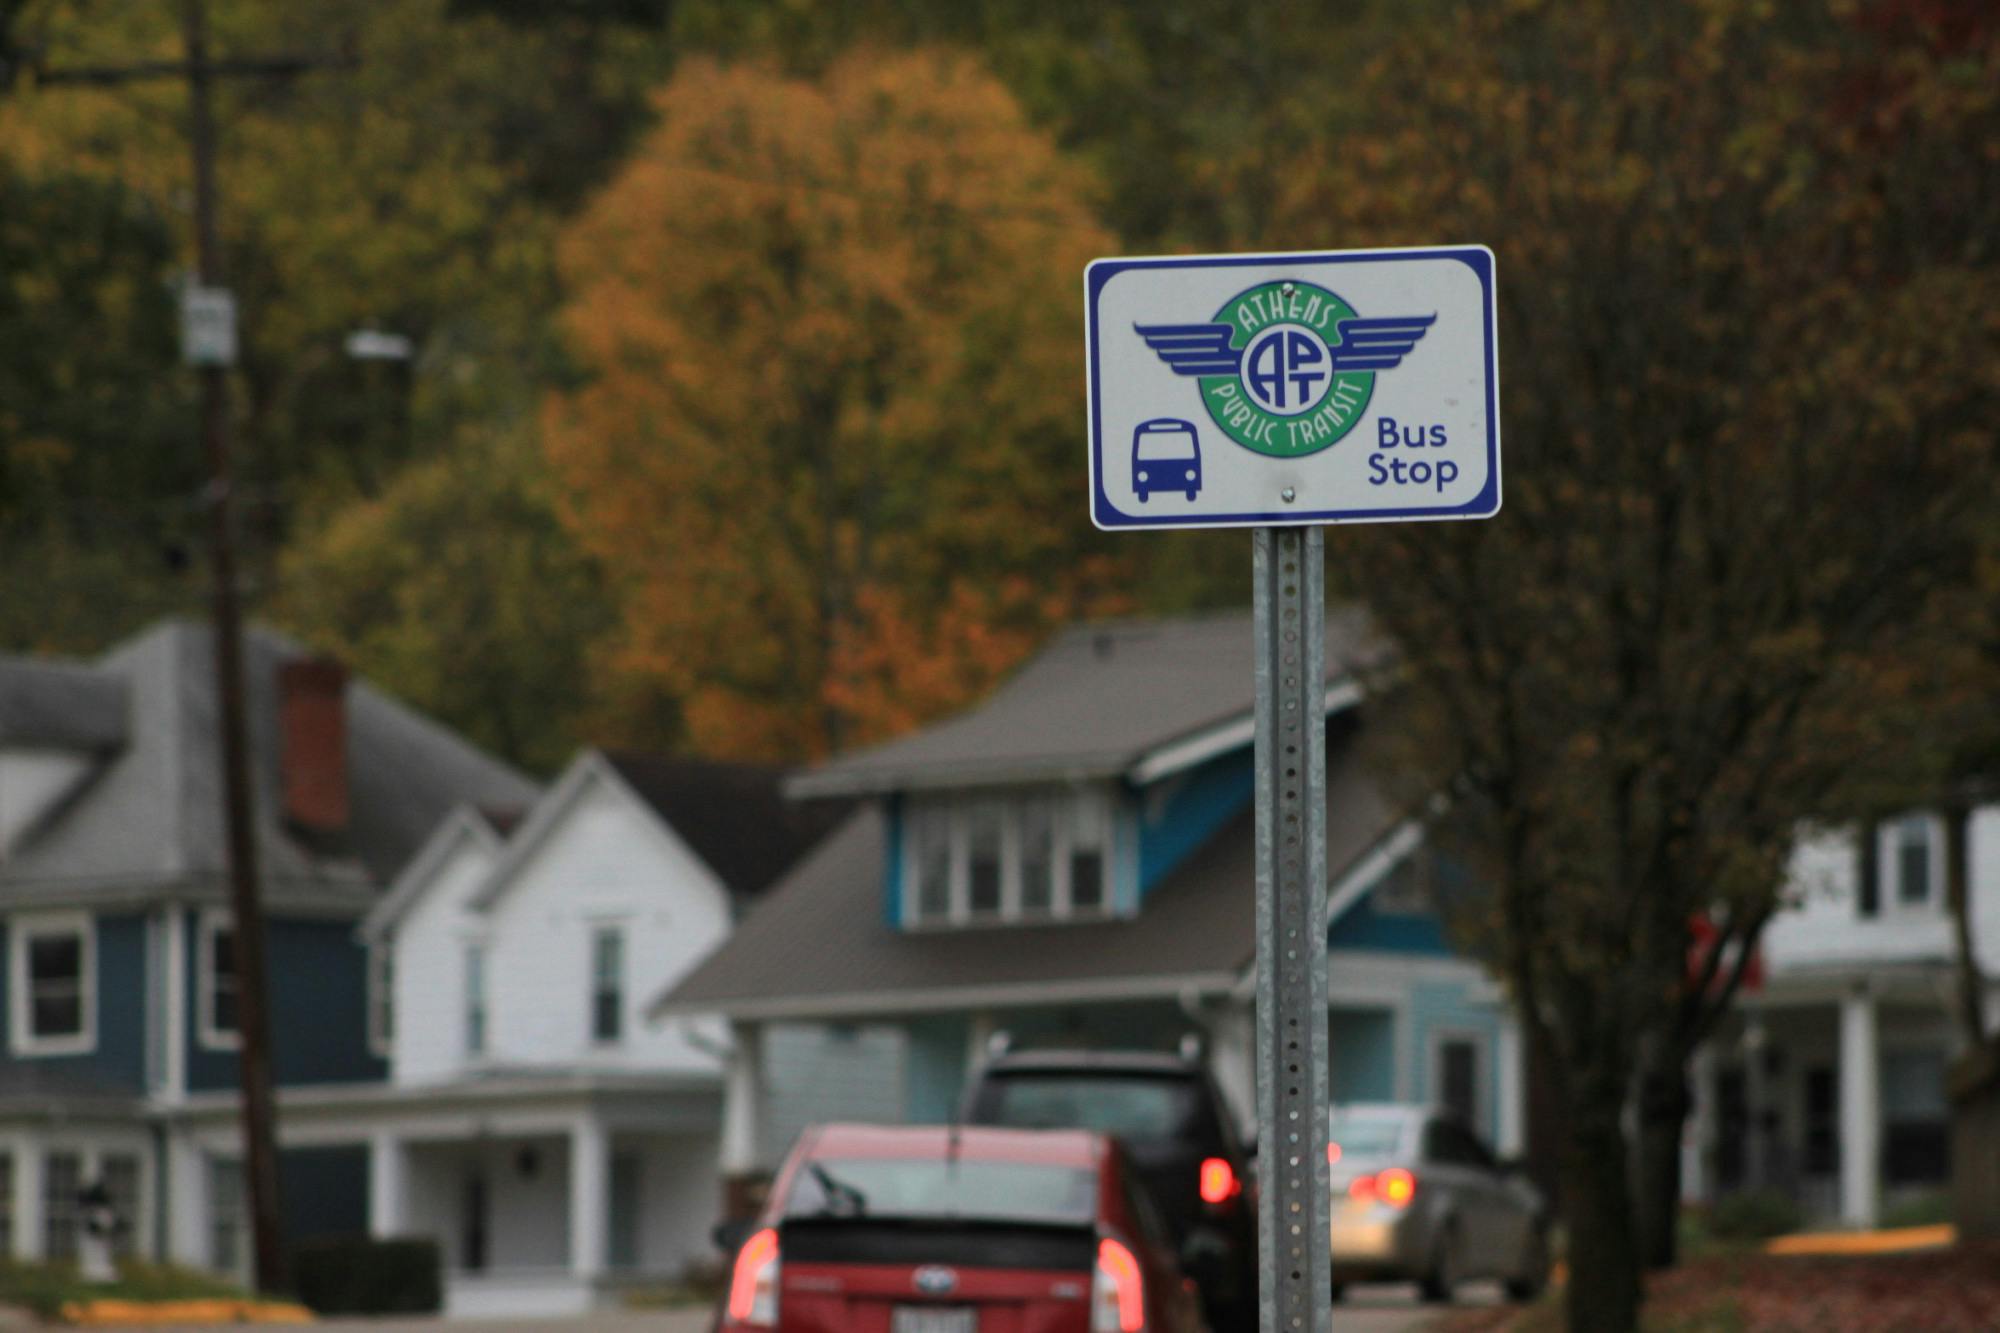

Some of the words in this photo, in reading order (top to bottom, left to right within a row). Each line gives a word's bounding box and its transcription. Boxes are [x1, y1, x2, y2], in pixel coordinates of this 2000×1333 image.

[1237, 290, 1336, 332] ATHENS
[1211, 383, 1278, 446] PUBLIC
[1286, 379, 1362, 447] TRANSIT
[1378, 417, 1447, 449] Bus
[1368, 453, 1458, 493] Stop
